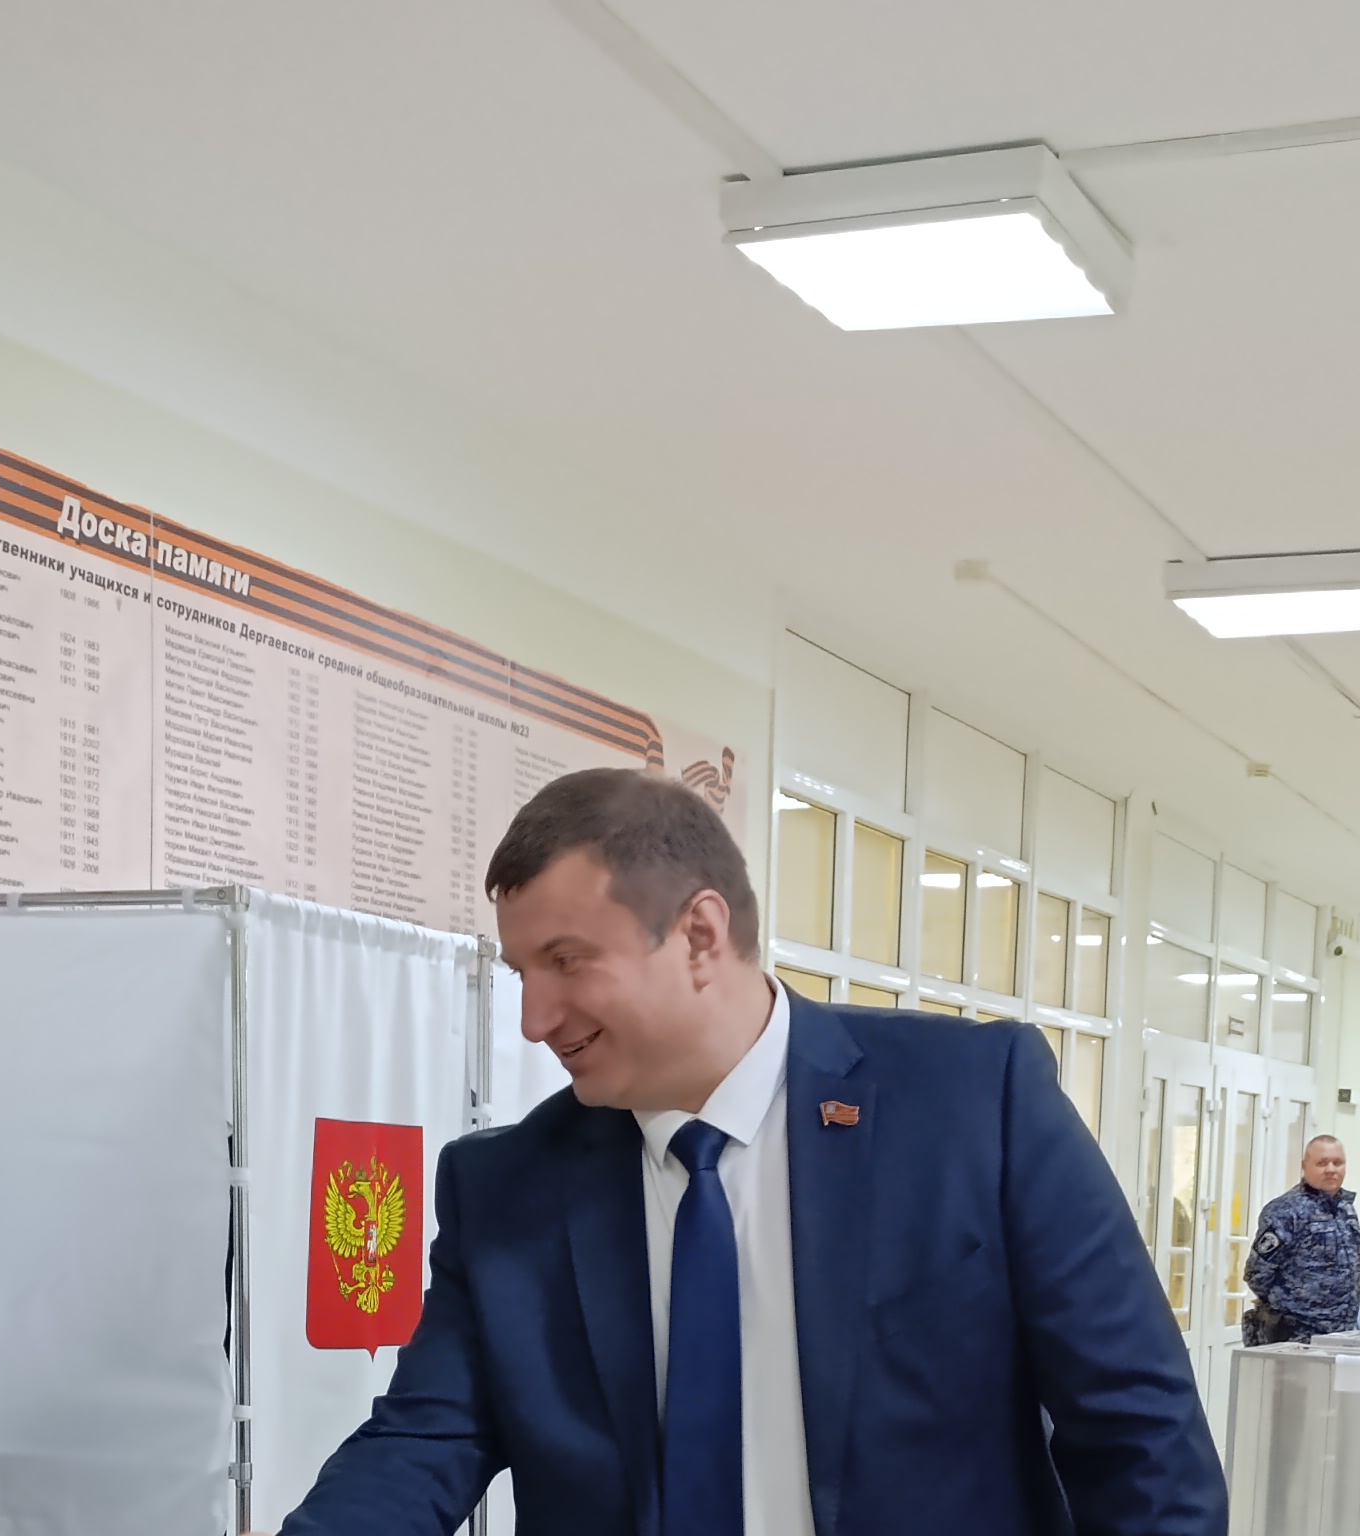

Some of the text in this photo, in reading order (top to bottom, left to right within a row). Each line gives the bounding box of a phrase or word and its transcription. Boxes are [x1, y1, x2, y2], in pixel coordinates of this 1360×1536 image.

[56, 494, 251, 597] Доска памяти
[68, 564, 139, 599] учащихся
[142, 591, 152, 604] и
[155, 595, 236, 634] сотрудников
[238, 621, 315, 661] Дергаевской
[317, 653, 363, 678] средней
[365, 669, 475, 718] общеобразовательной
[476, 711, 507, 730] школы
[509, 720, 530, 739] №23
